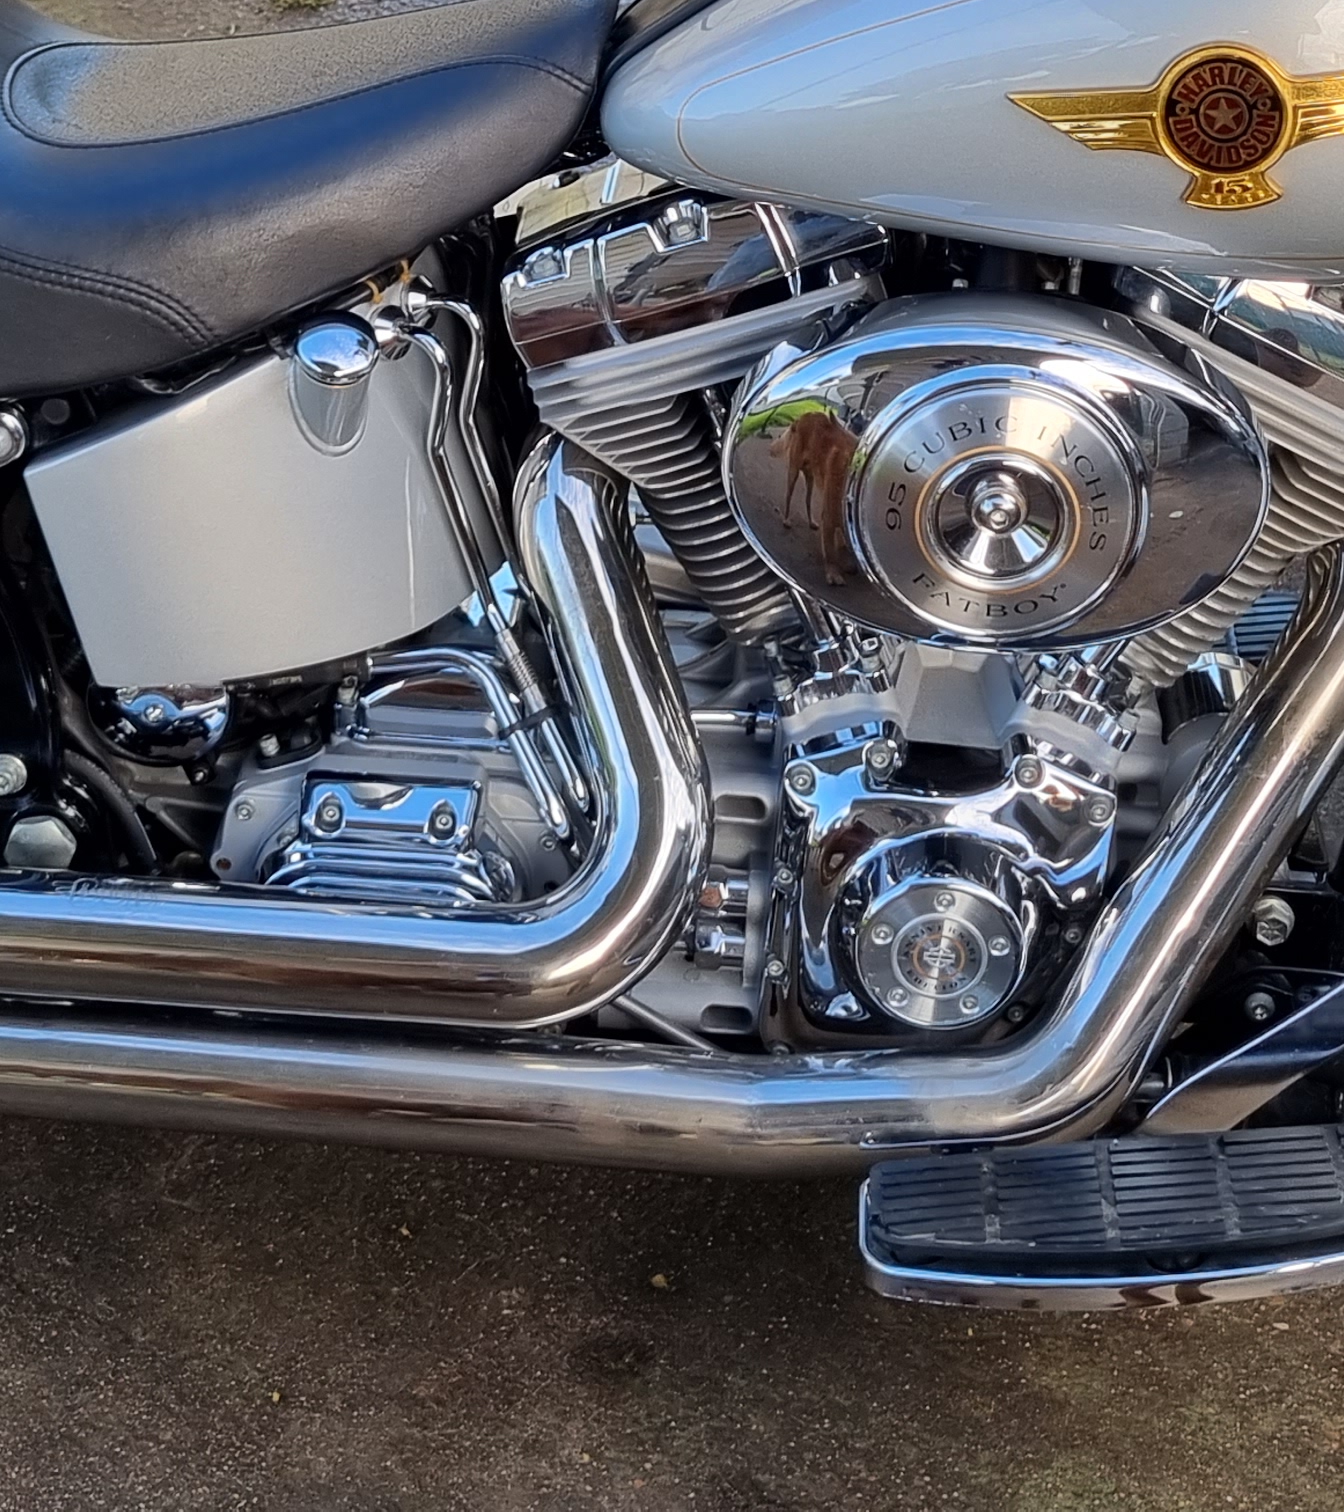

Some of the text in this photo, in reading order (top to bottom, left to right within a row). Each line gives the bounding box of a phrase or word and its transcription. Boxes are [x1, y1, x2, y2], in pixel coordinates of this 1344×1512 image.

[1172, 62, 1274, 109] HARLEY
[1169, 109, 1279, 167] DAVIDSON
[1211, 177, 1254, 195] 15
[885, 416, 1110, 552] 95 CUBIC INCHES
